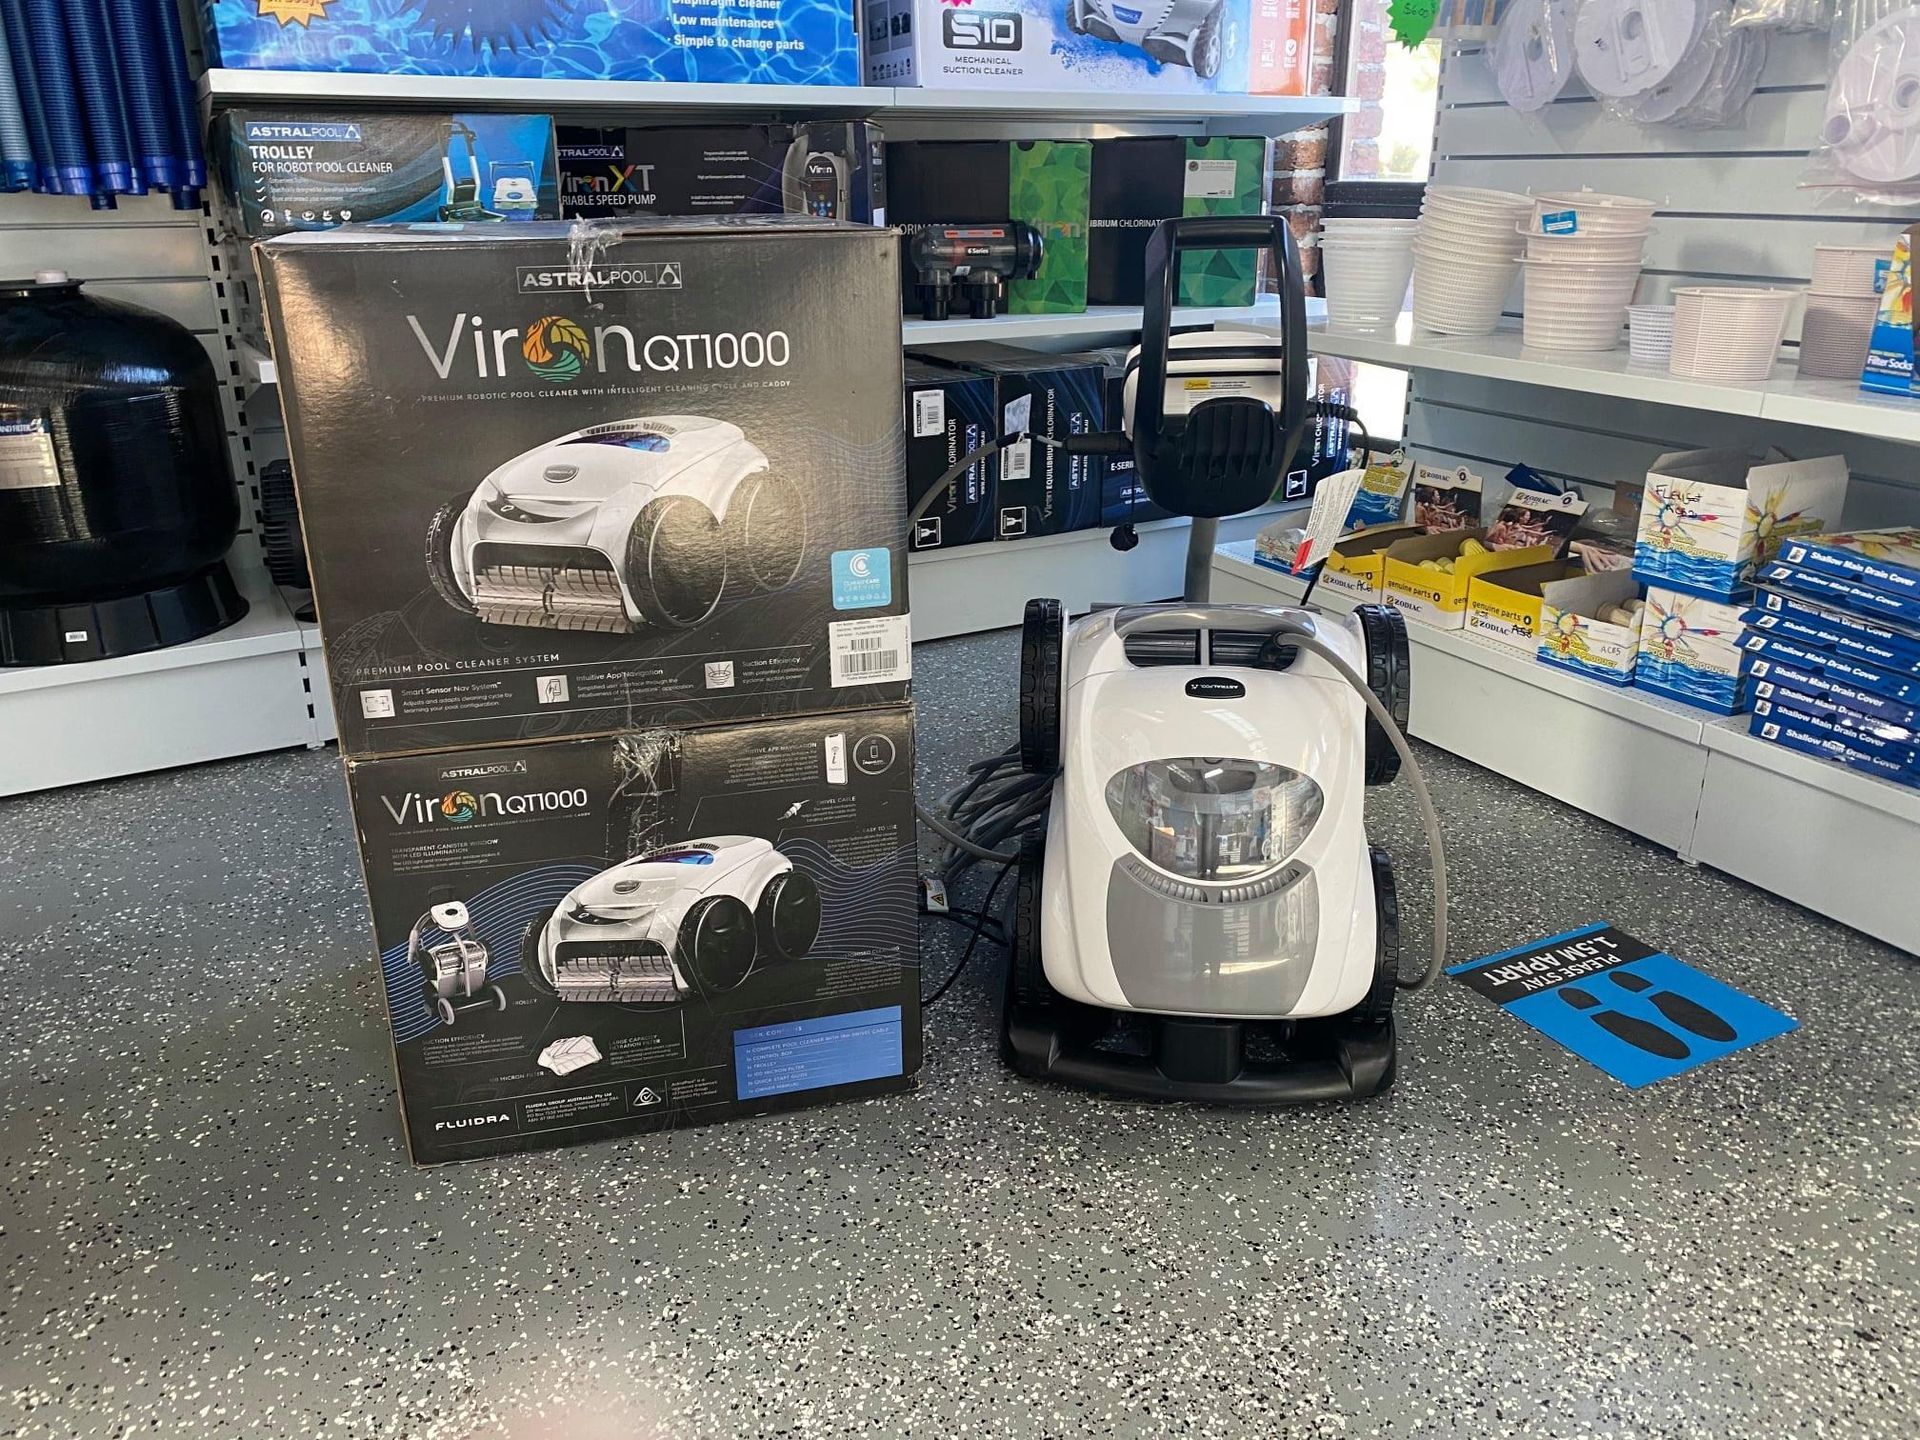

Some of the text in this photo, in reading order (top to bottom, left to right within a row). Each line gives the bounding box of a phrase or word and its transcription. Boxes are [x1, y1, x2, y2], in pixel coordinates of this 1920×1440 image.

[673, 13, 774, 28] Low maintenance
[951, 14, 1015, 45] S10
[674, 35, 804, 51] Simple to change parts
[955, 56, 1012, 65] MECHANICAL
[943, 66, 1024, 75] SUCTION CLEANER
[250, 126, 342, 138] ASTRALPOOL
[249, 146, 314, 159] TROLLEY
[252, 162, 394, 174] FOR ROBOT POOL CLEANER
[596, 194, 656, 206] SPEED PUMP
[523, 270, 654, 287] ASTRALPOOL
[1867, 354, 1889, 367] Filter
[1889, 356, 1914, 370] Socks
[422, 394, 463, 402] PREMIUM
[467, 392, 508, 400] ROBOTIC
[510, 390, 534, 398] POOL
[538, 388, 578, 397] CLEANER
[607, 386, 662, 395] INTELLIGENT
[664, 384, 709, 393] CLEANING
[762, 380, 791, 388] CADDY
[1688, 546, 1728, 561] PRODUCT
[1810, 551, 1916, 587] Shallow Main Drain Cover
[1330, 578, 1355, 590] ZODIAC
[1387, 580, 1431, 598] genuine parts
[1796, 573, 1903, 608] Shallow Main Drain Cover
[1394, 598, 1422, 612] ZODIAC
[1472, 600, 1521, 622] genuine parts
[1480, 621, 1511, 636] ZODIAC
[1842, 617, 1865, 631] Drain
[1866, 626, 1893, 639] Cover
[1783, 621, 1894, 658] Shallow Main Drain Cover
[356, 654, 560, 677] PREMIUM POOL CLEANER SYSTEM
[769, 657, 800, 665] Efficiency
[1688, 660, 1730, 674] PRODUCT
[1771, 642, 1880, 682] Shallow Main Drain Cover
[606, 672, 621, 680] App
[624, 669, 663, 678] Navigation
[1774, 667, 1885, 707] Shallow Main Drain Cover
[1779, 688, 1863, 719] Shallow Main Drain
[1777, 706, 1886, 747] Shallow Main Drain Cover
[1786, 729, 1901, 771] Shallow Main Drain Cover
[441, 765, 510, 779] ASTRALPOOL
[392, 839, 499, 853] TRANSPARENT CANISTER WINDOW
[423, 848, 469, 856] ILLUMINATION
[1482, 936, 1618, 986] 1.5M APART
[1521, 953, 1622, 991] PLEASE STAY
[800, 1037, 824, 1046] CLEANER
[434, 1114, 510, 1131] FLUIDRA
